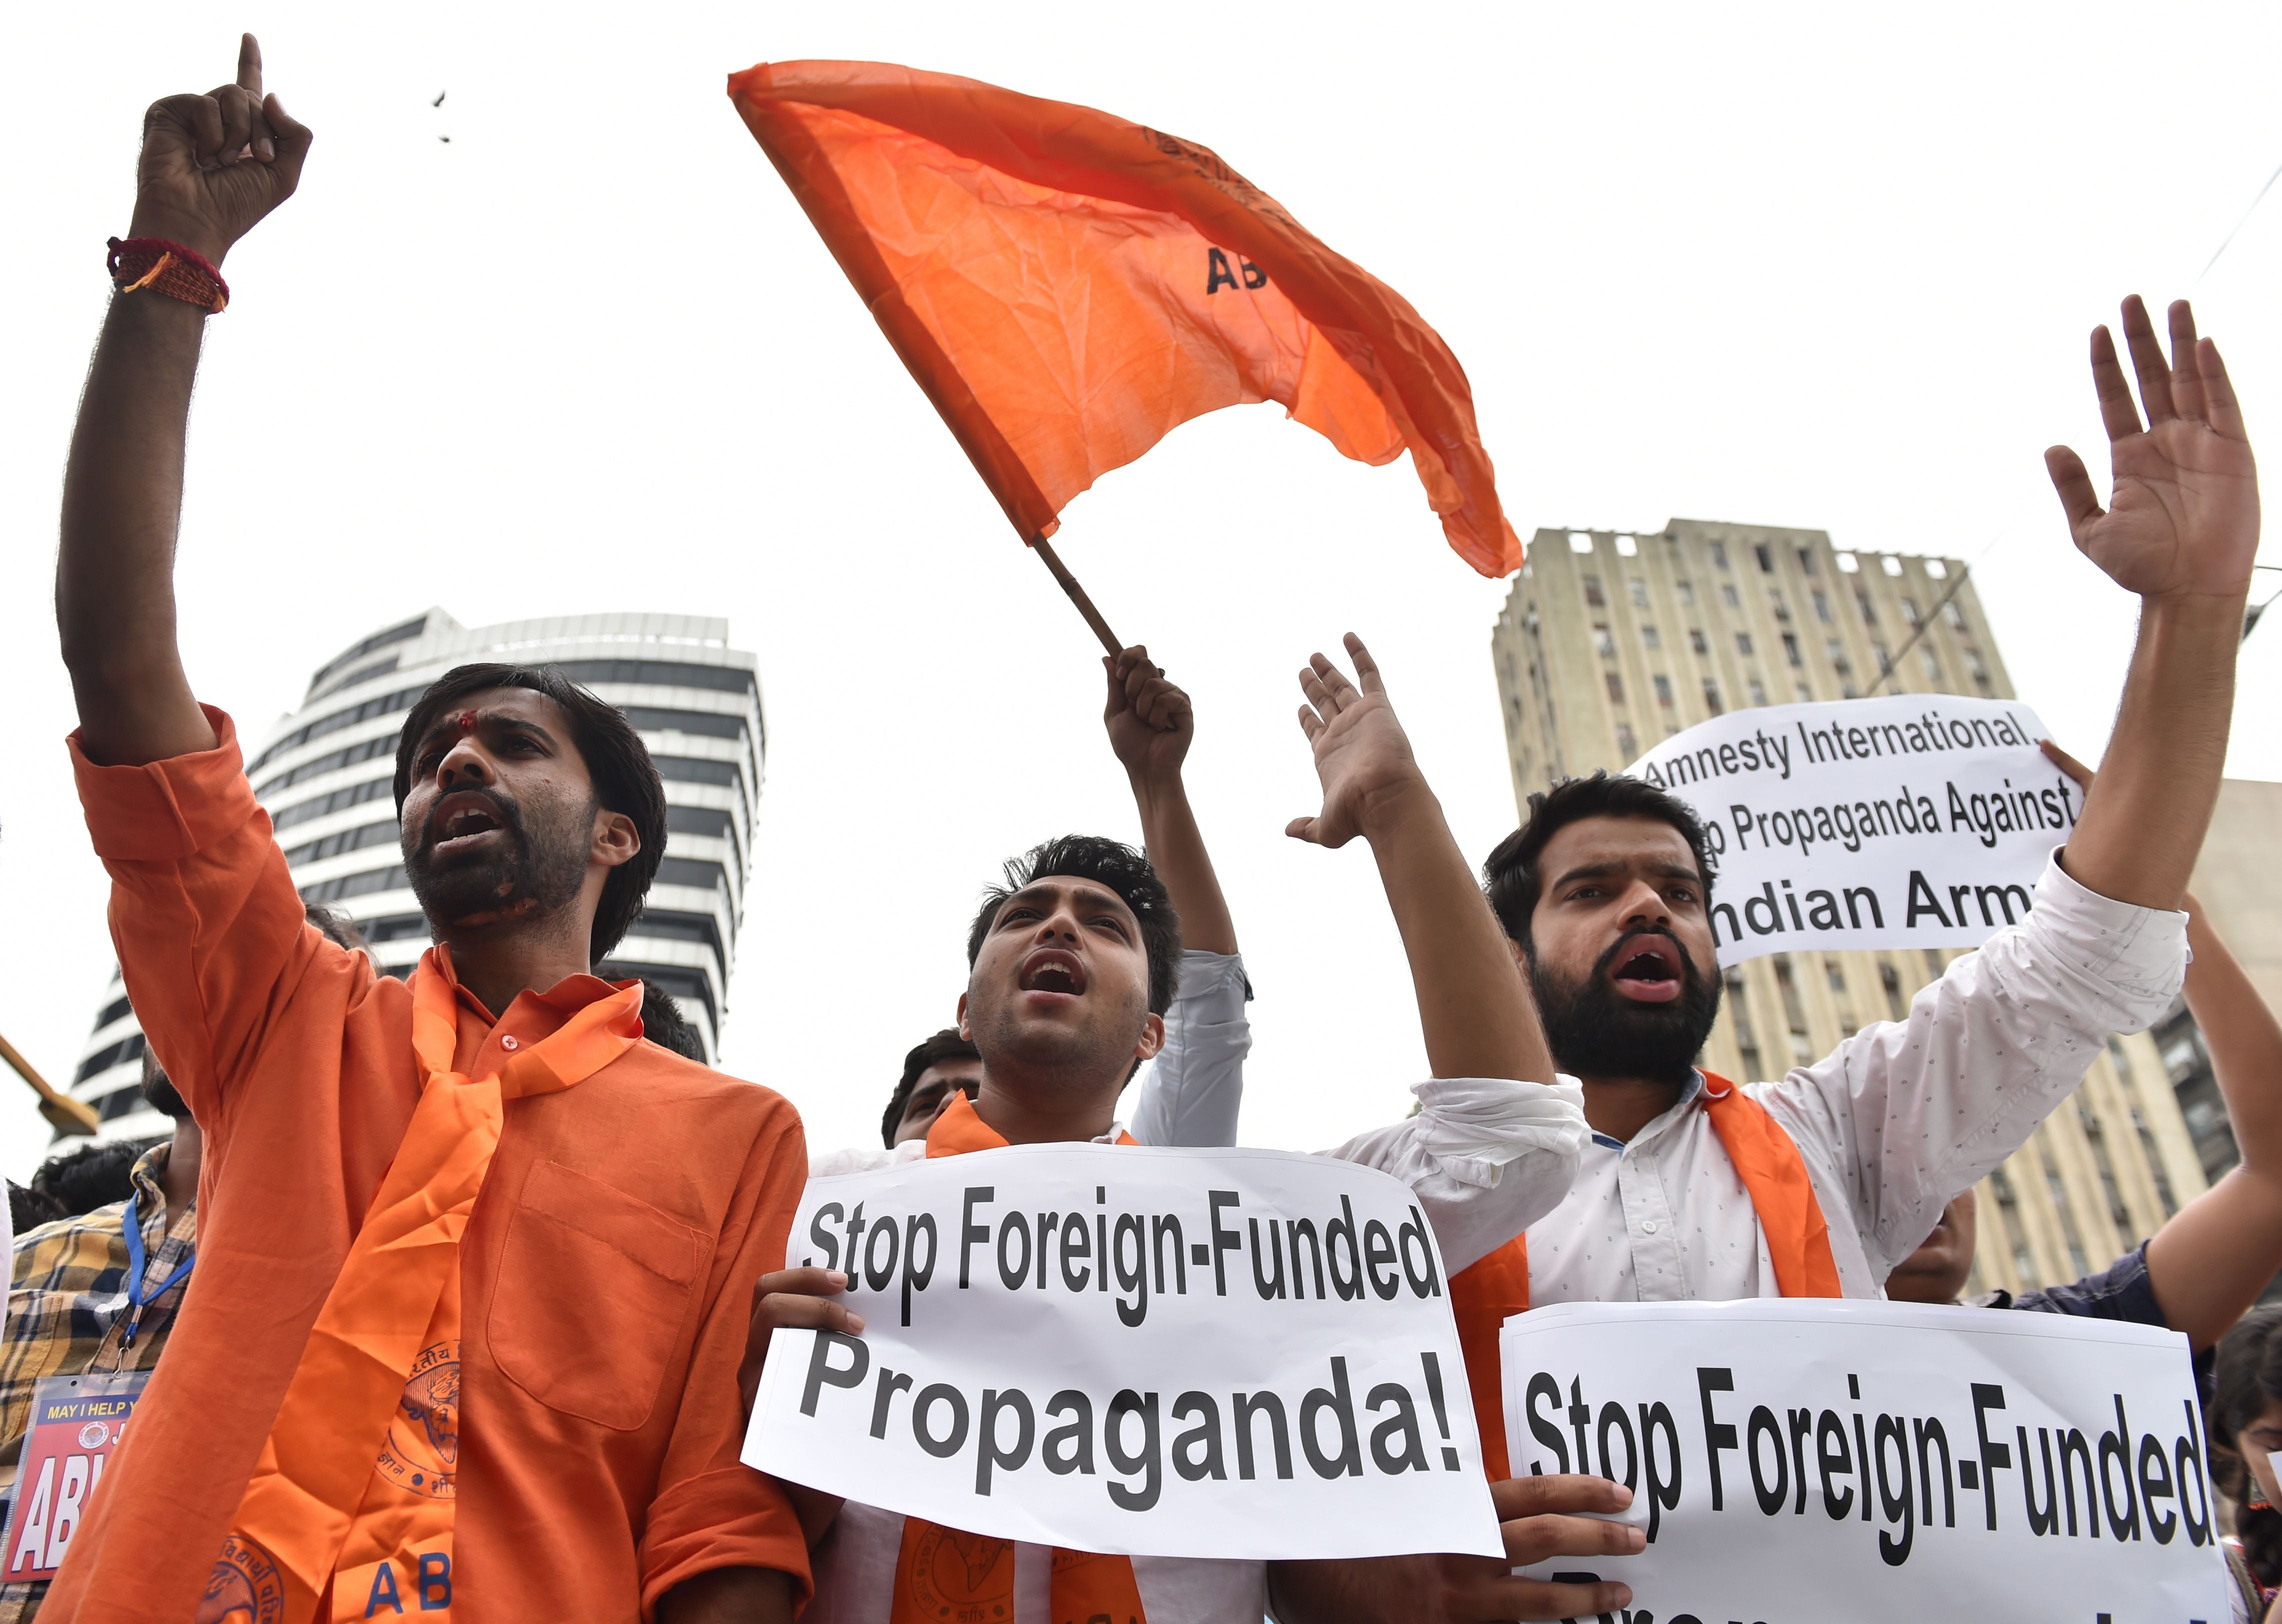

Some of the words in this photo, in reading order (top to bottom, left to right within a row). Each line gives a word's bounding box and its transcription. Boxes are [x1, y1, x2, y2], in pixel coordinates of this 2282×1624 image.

[1644, 728, 1790, 788] Amnesty
[1730, 785, 1942, 856] Propaganda
[1946, 776, 2079, 848] Against
[1709, 878, 1885, 948] ndian
[1906, 870, 2036, 928] Arm
[802, 1200, 938, 1328] Stop
[959, 1186, 1442, 1328] Foreign-Funded
[47, 1404, 78, 1420] MAY
[80, 1404, 86, 1417] I
[87, 1401, 126, 1416] HELP
[799, 1329, 1462, 1512] Propaganda!
[1526, 1372, 1682, 1544] Stop
[1696, 1367, 2214, 1567] Foreign-Funded
